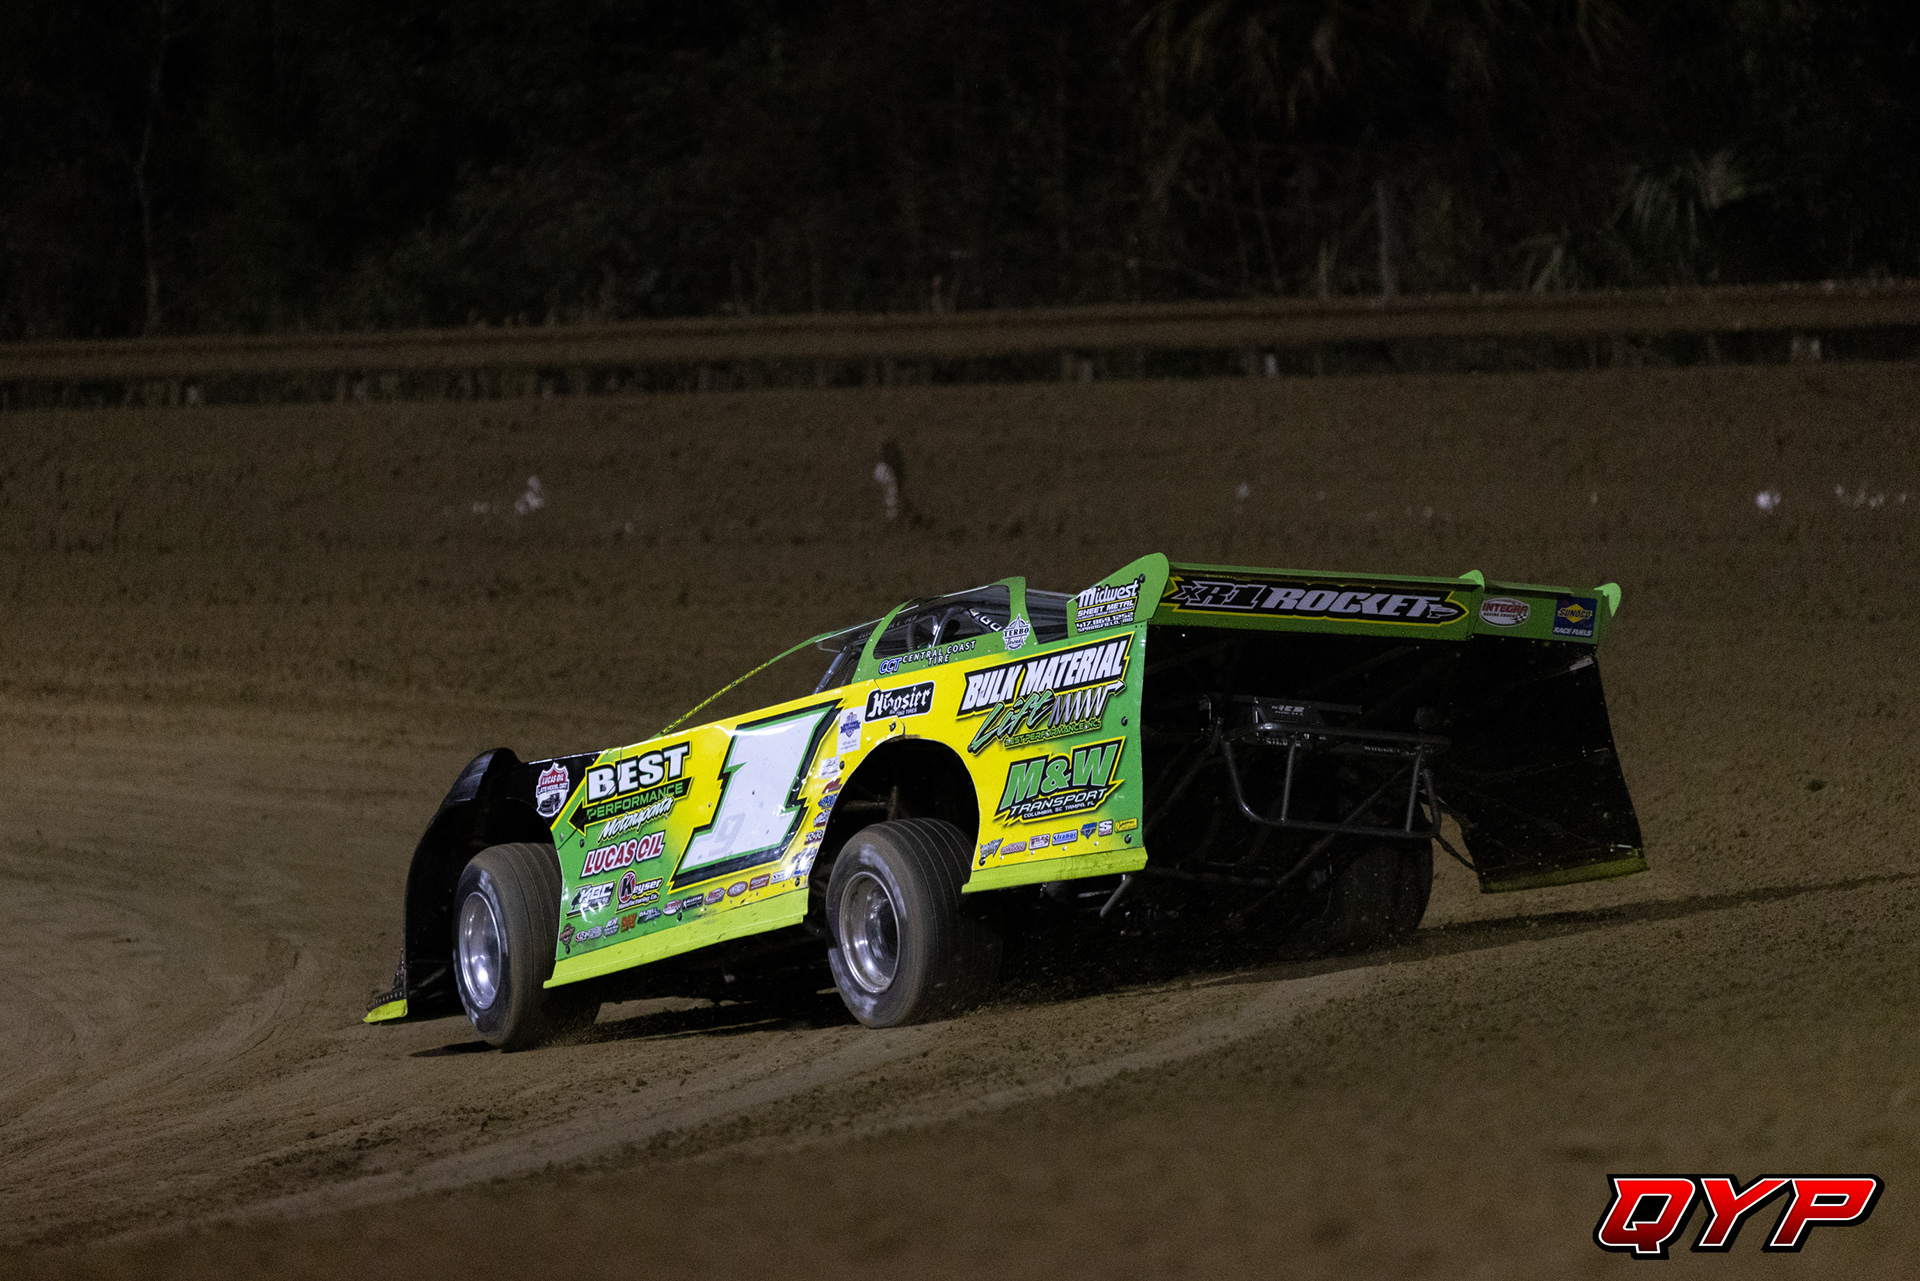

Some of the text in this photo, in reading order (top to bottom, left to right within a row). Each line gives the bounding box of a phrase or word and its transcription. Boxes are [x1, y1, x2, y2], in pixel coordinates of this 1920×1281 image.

[1079, 579, 1138, 608] Midwest
[1260, 587, 1441, 617] ROCKET
[1077, 606, 1105, 617] SHEET
[1107, 600, 1134, 611] METAL
[1481, 603, 1528, 613] INTEGRA
[1558, 609, 1593, 619] SUNOCO
[1004, 627, 1029, 637] TERBO
[1553, 627, 1593, 637] RACE FUELS
[879, 657, 902, 674] CCT
[902, 640, 976, 663] CENTRAL COAST
[928, 654, 950, 666] TIRE
[961, 640, 1127, 710] BULK MATERIAL
[867, 687, 931, 718] Hoosier
[971, 690, 1054, 751] Lift
[542, 774, 565, 785] LUCAS OIL
[588, 745, 688, 801] BEST
[1000, 743, 1118, 810] M&W
[587, 782, 684, 820] PERFORMANCE
[678, 704, 835, 873] 1
[1010, 788, 1107, 816] TRANSPORT
[598, 796, 674, 841] Motorsports
[582, 832, 664, 876] LUCAS OIL
[620, 875, 662, 897] Keyser
